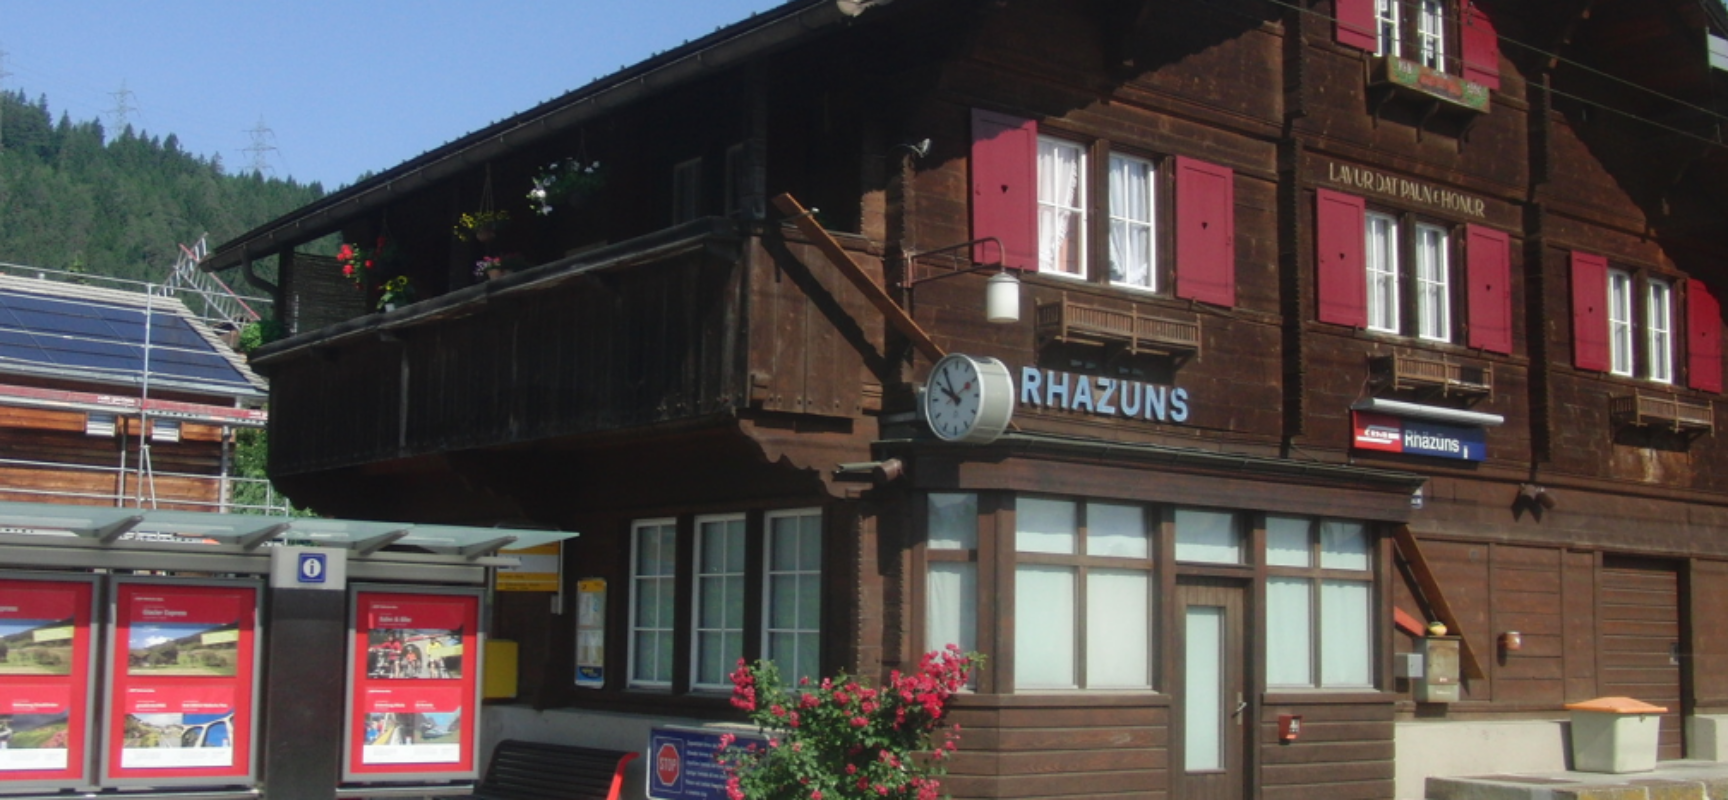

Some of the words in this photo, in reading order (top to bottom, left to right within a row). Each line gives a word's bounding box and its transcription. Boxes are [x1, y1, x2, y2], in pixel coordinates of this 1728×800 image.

[1329, 162, 1374, 191] LAVUR
[1376, 172, 1398, 196] DAT
[1400, 179, 1433, 205] PAUN
[1441, 189, 1486, 218] HONUR
[1404, 430, 1460, 453] Rhäzüns
[660, 758, 676, 772] STOP
